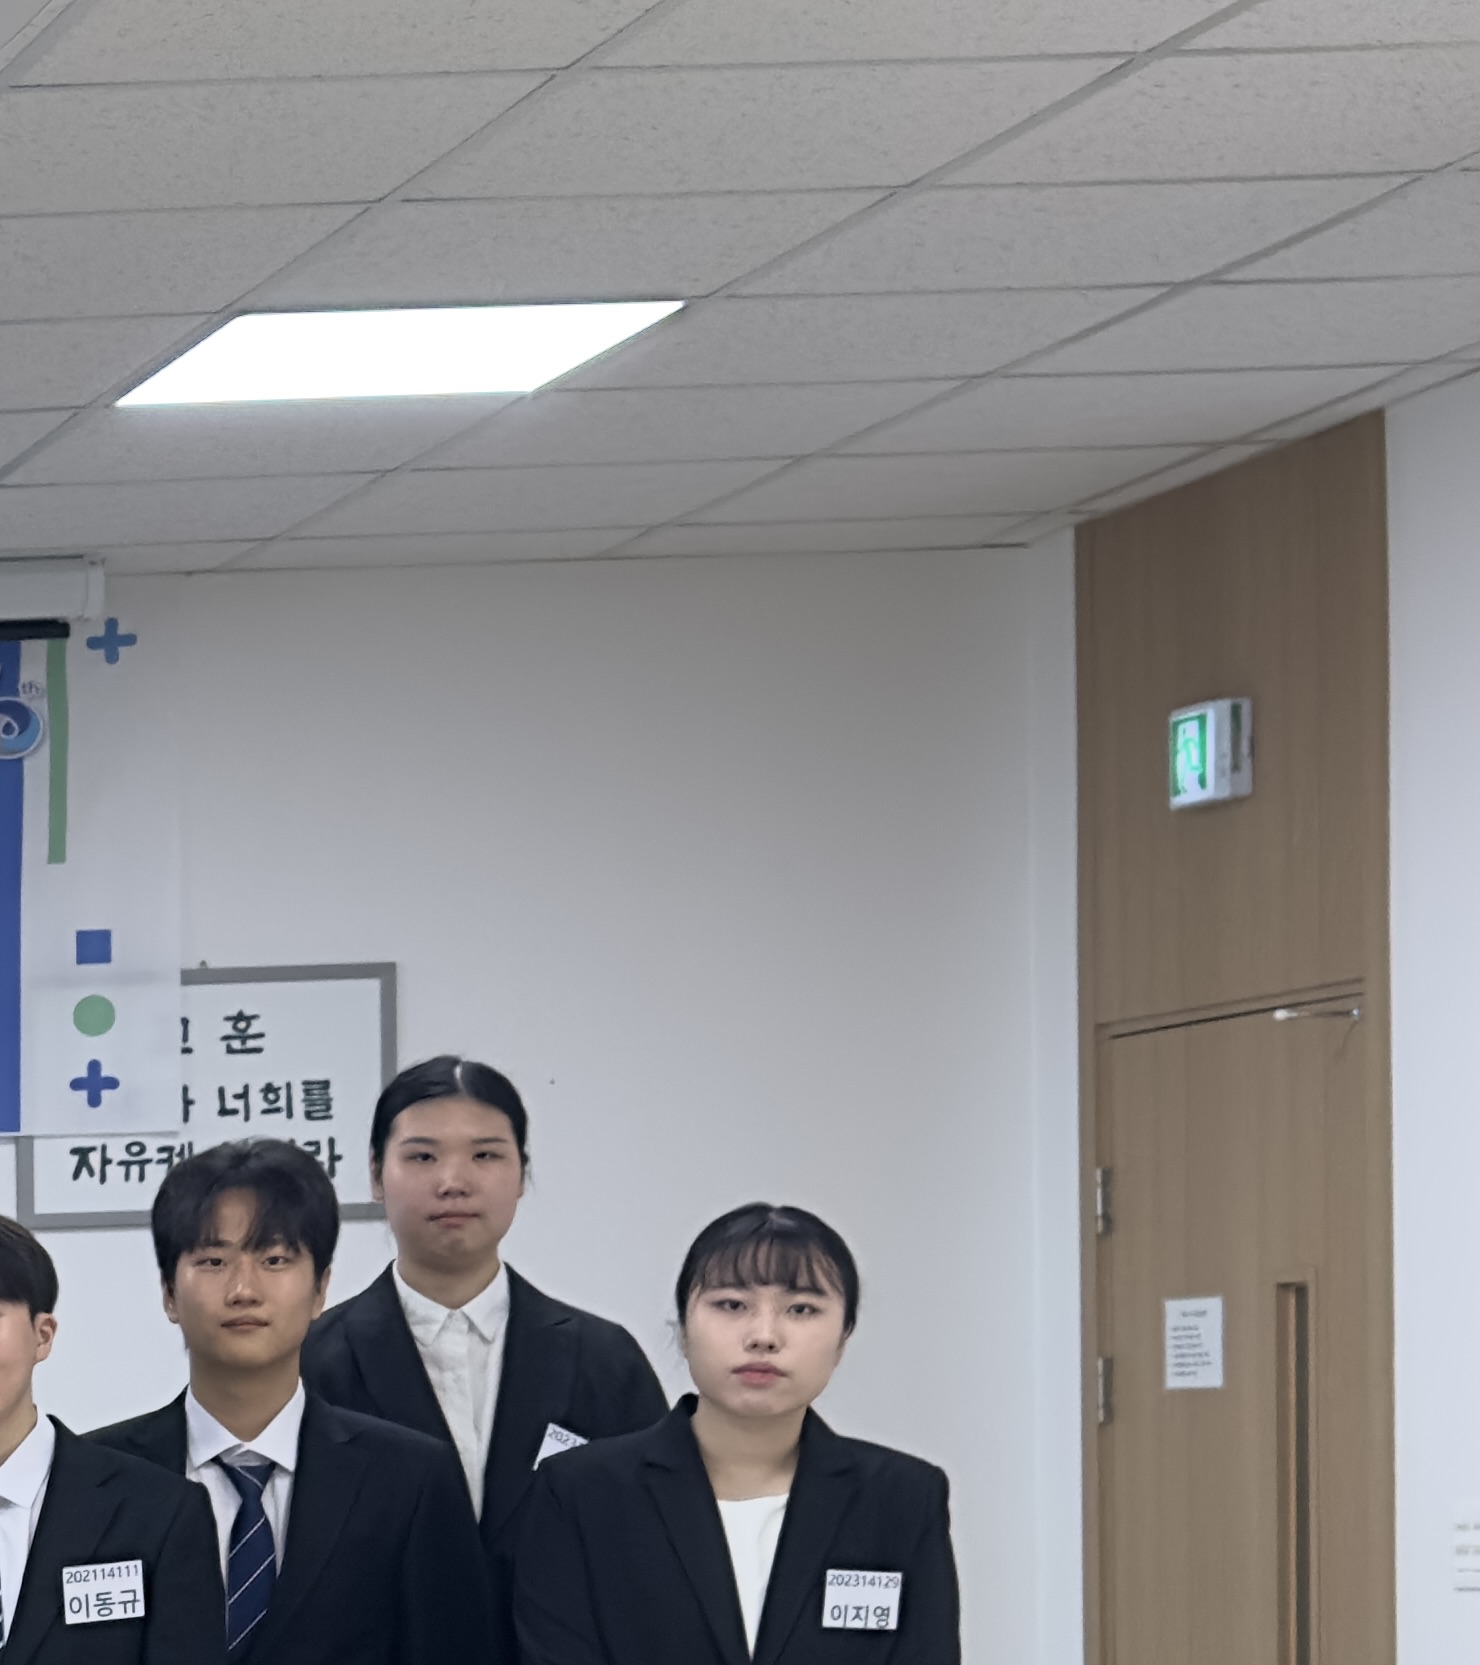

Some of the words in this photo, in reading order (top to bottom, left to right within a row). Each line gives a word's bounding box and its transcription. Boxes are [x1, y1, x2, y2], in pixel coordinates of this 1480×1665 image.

[220, 1008, 266, 1056] 훈
[216, 1078, 334, 1123] 너희를
[66, 1564, 139, 1584] 202114111
[69, 1589, 141, 1619] 이동규
[830, 1604, 890, 1629] 이지영
